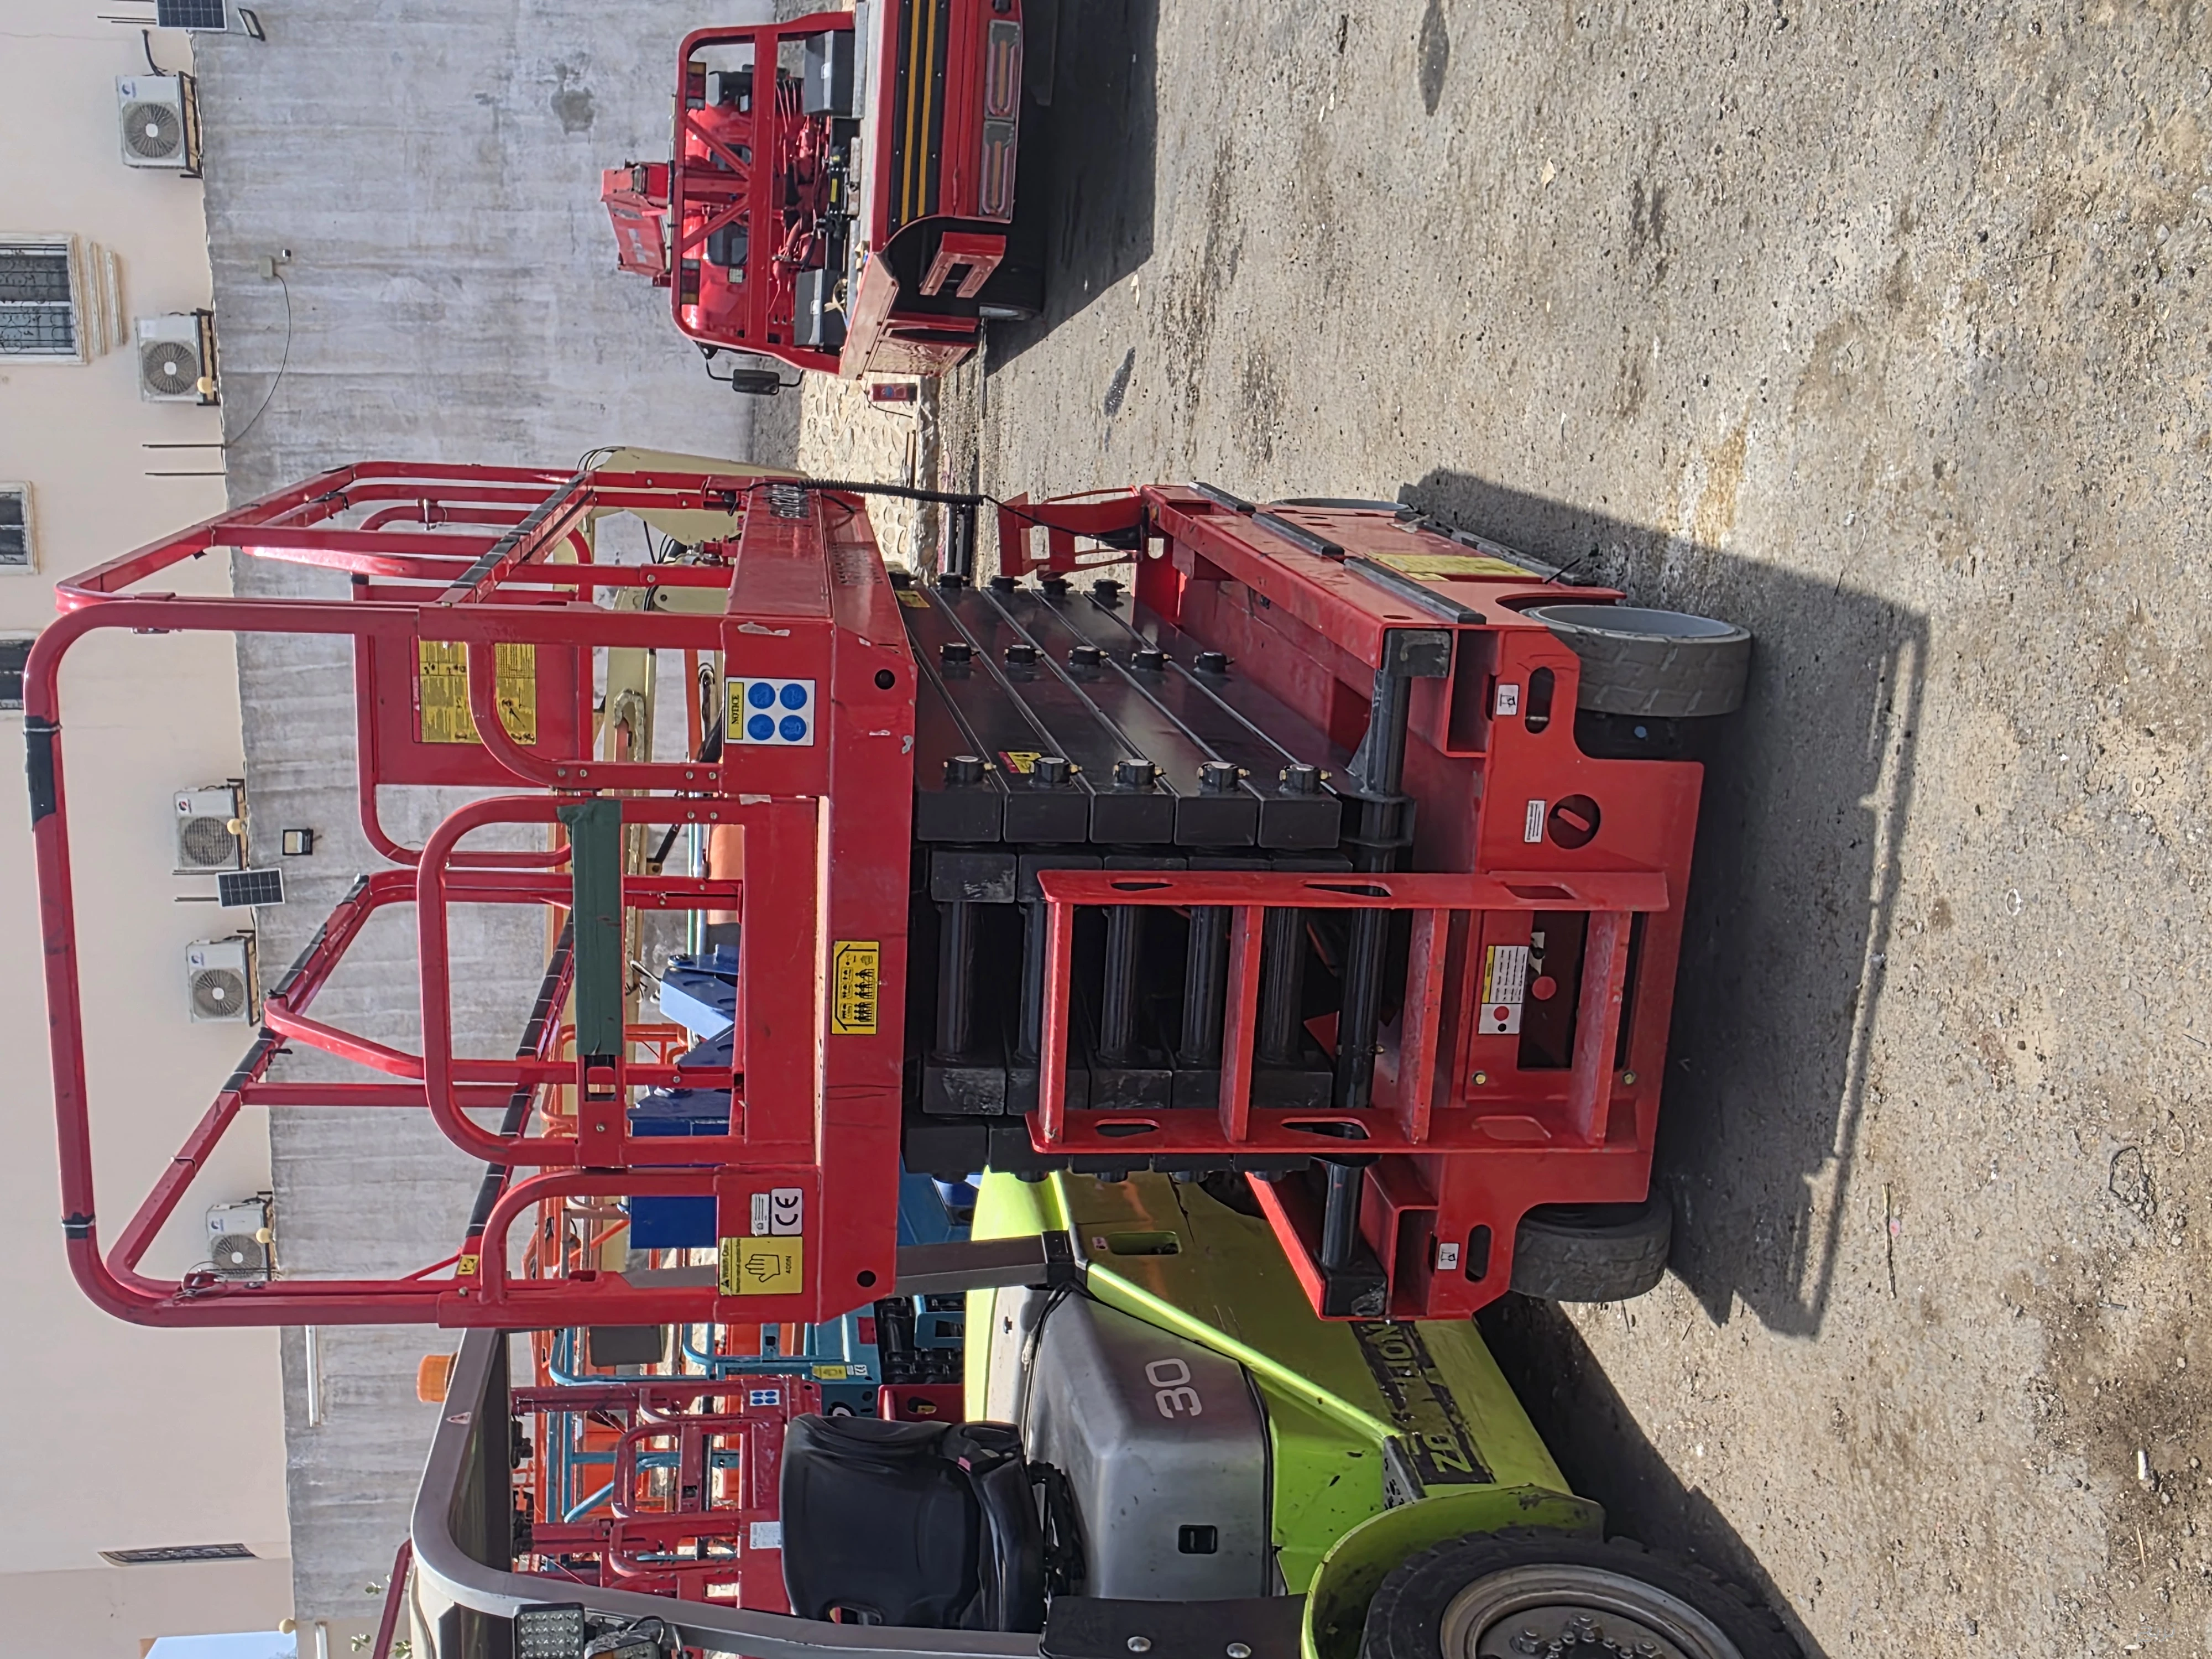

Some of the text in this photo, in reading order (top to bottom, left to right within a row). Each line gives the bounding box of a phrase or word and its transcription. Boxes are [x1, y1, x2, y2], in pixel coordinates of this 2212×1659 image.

[731, 694, 739, 724] NOTICE
[774, 1196, 799, 1226] CE
[1145, 1358, 1202, 1418] 30
